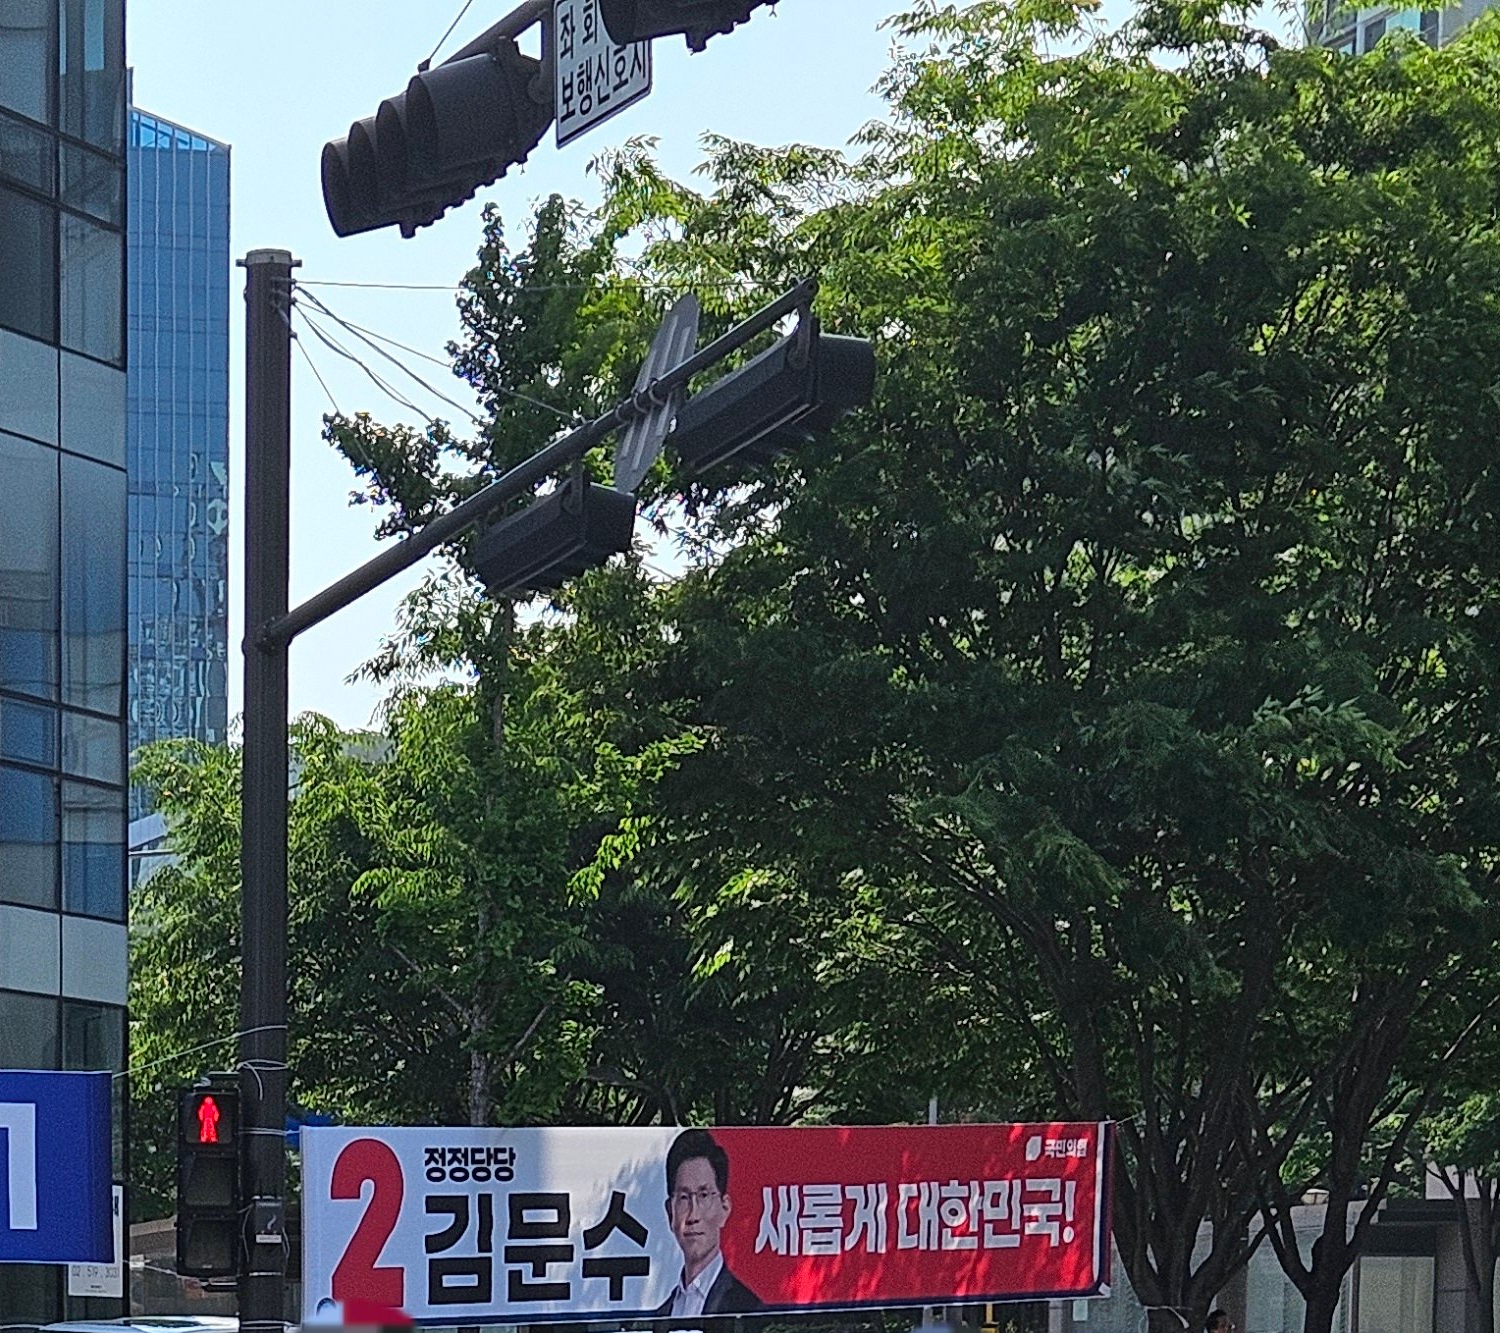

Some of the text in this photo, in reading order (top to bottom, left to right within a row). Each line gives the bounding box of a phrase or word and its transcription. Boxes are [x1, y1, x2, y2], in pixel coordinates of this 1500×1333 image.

[560, 0, 599, 59] 좌회
[560, 40, 646, 123] 보행신호시
[424, 1146, 517, 1183] 정정당당
[329, 1138, 405, 1307] 2
[423, 1190, 650, 1306] 김문수
[755, 1178, 1077, 1257] 새롭게 대한민국!
